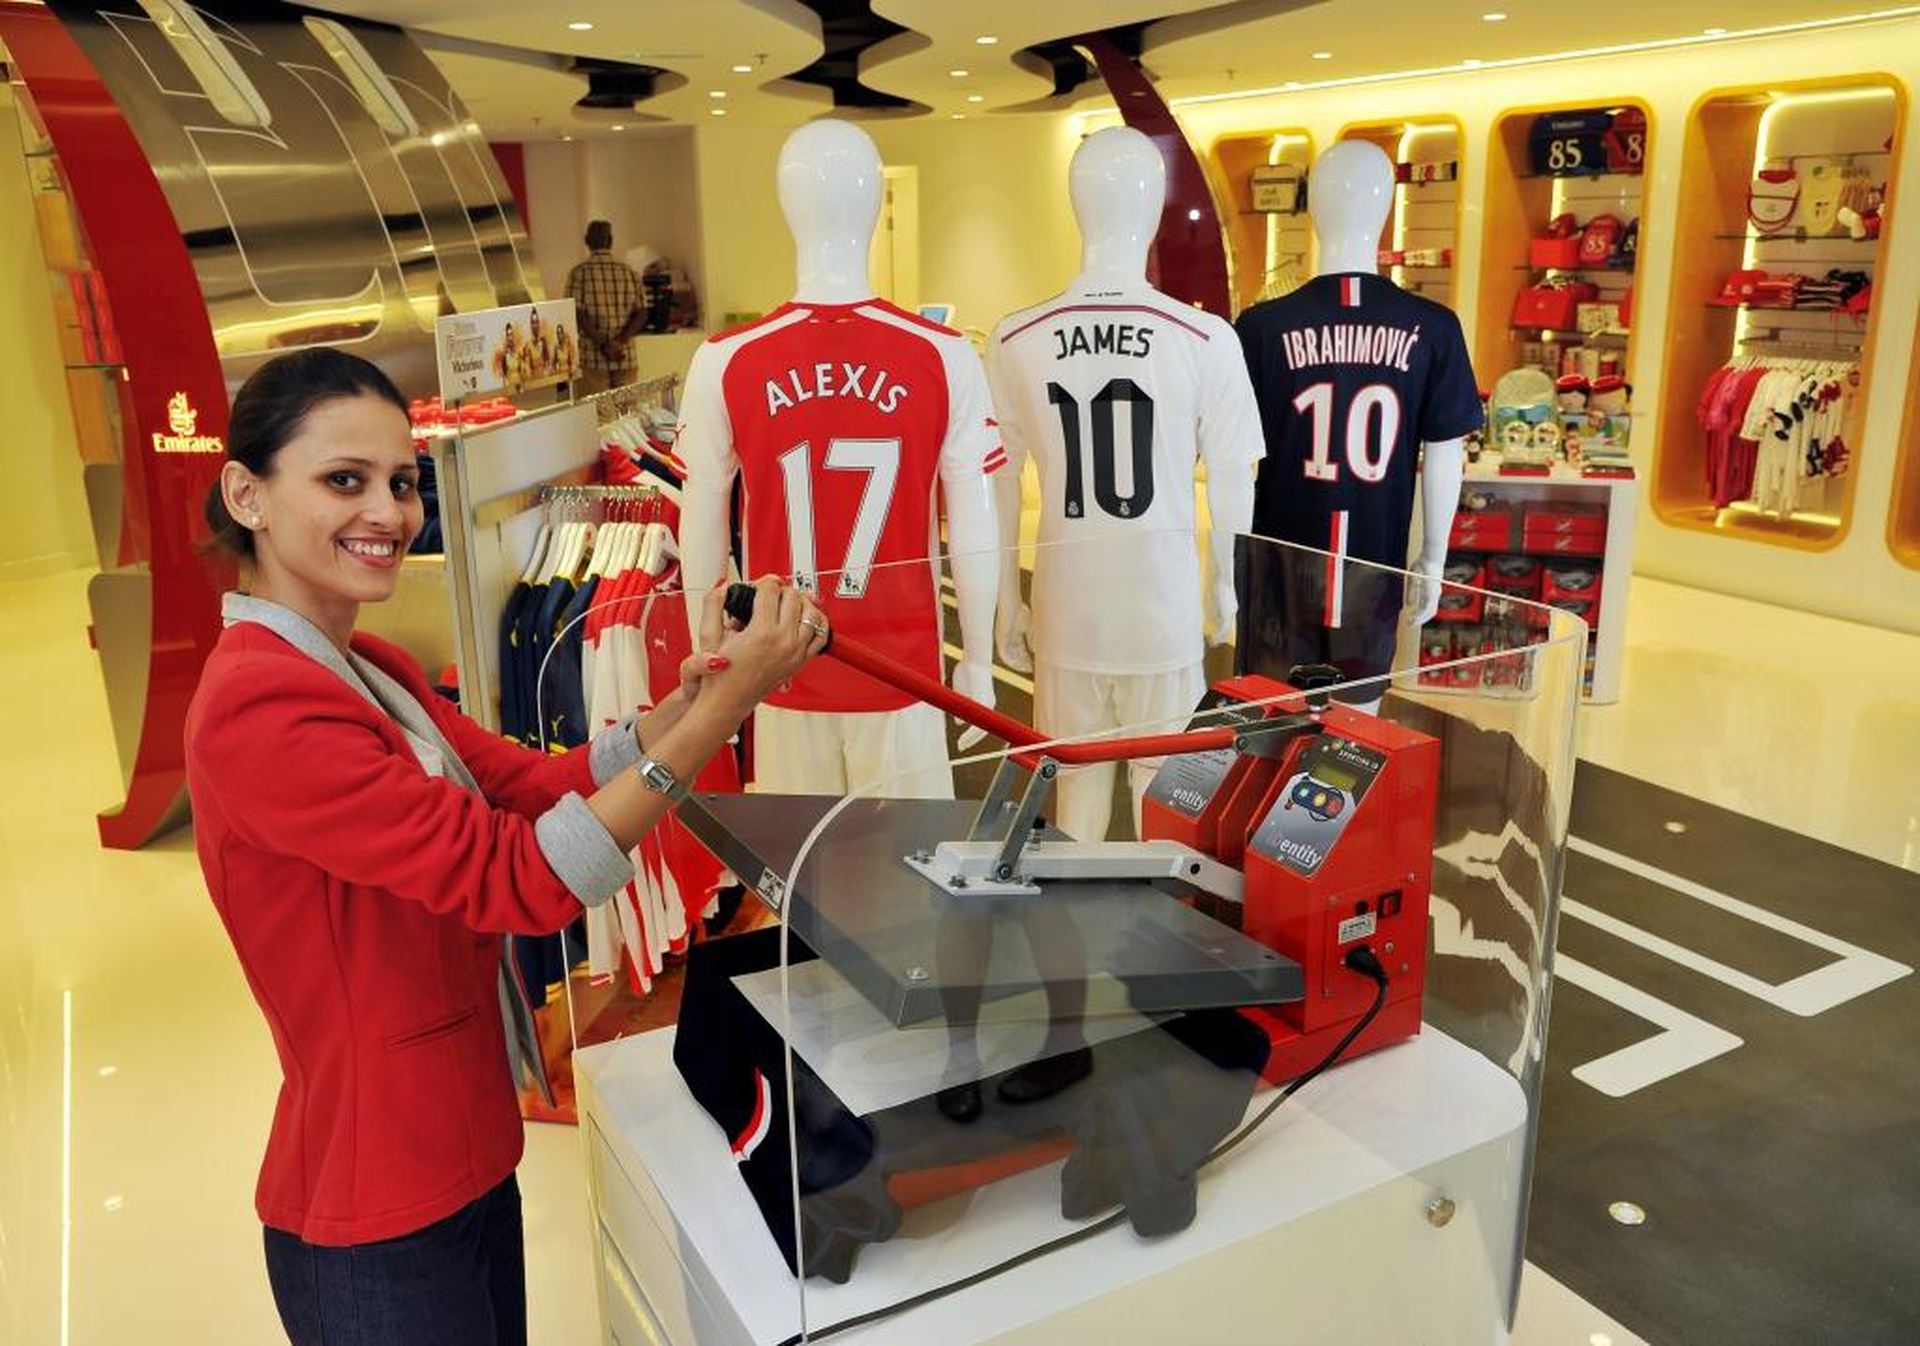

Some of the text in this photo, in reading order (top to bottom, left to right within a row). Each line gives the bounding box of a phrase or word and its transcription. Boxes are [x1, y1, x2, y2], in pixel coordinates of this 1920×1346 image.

[1549, 138, 1582, 169] 85
[1053, 323, 1154, 360] JAMES
[1282, 325, 1421, 372] IBRAHIMOVIĆ
[765, 362, 909, 417] ALEXIS
[152, 433, 224, 453] Emirates
[1047, 378, 1154, 519] 10
[1292, 382, 1400, 483] 10
[777, 437, 902, 600] 17
